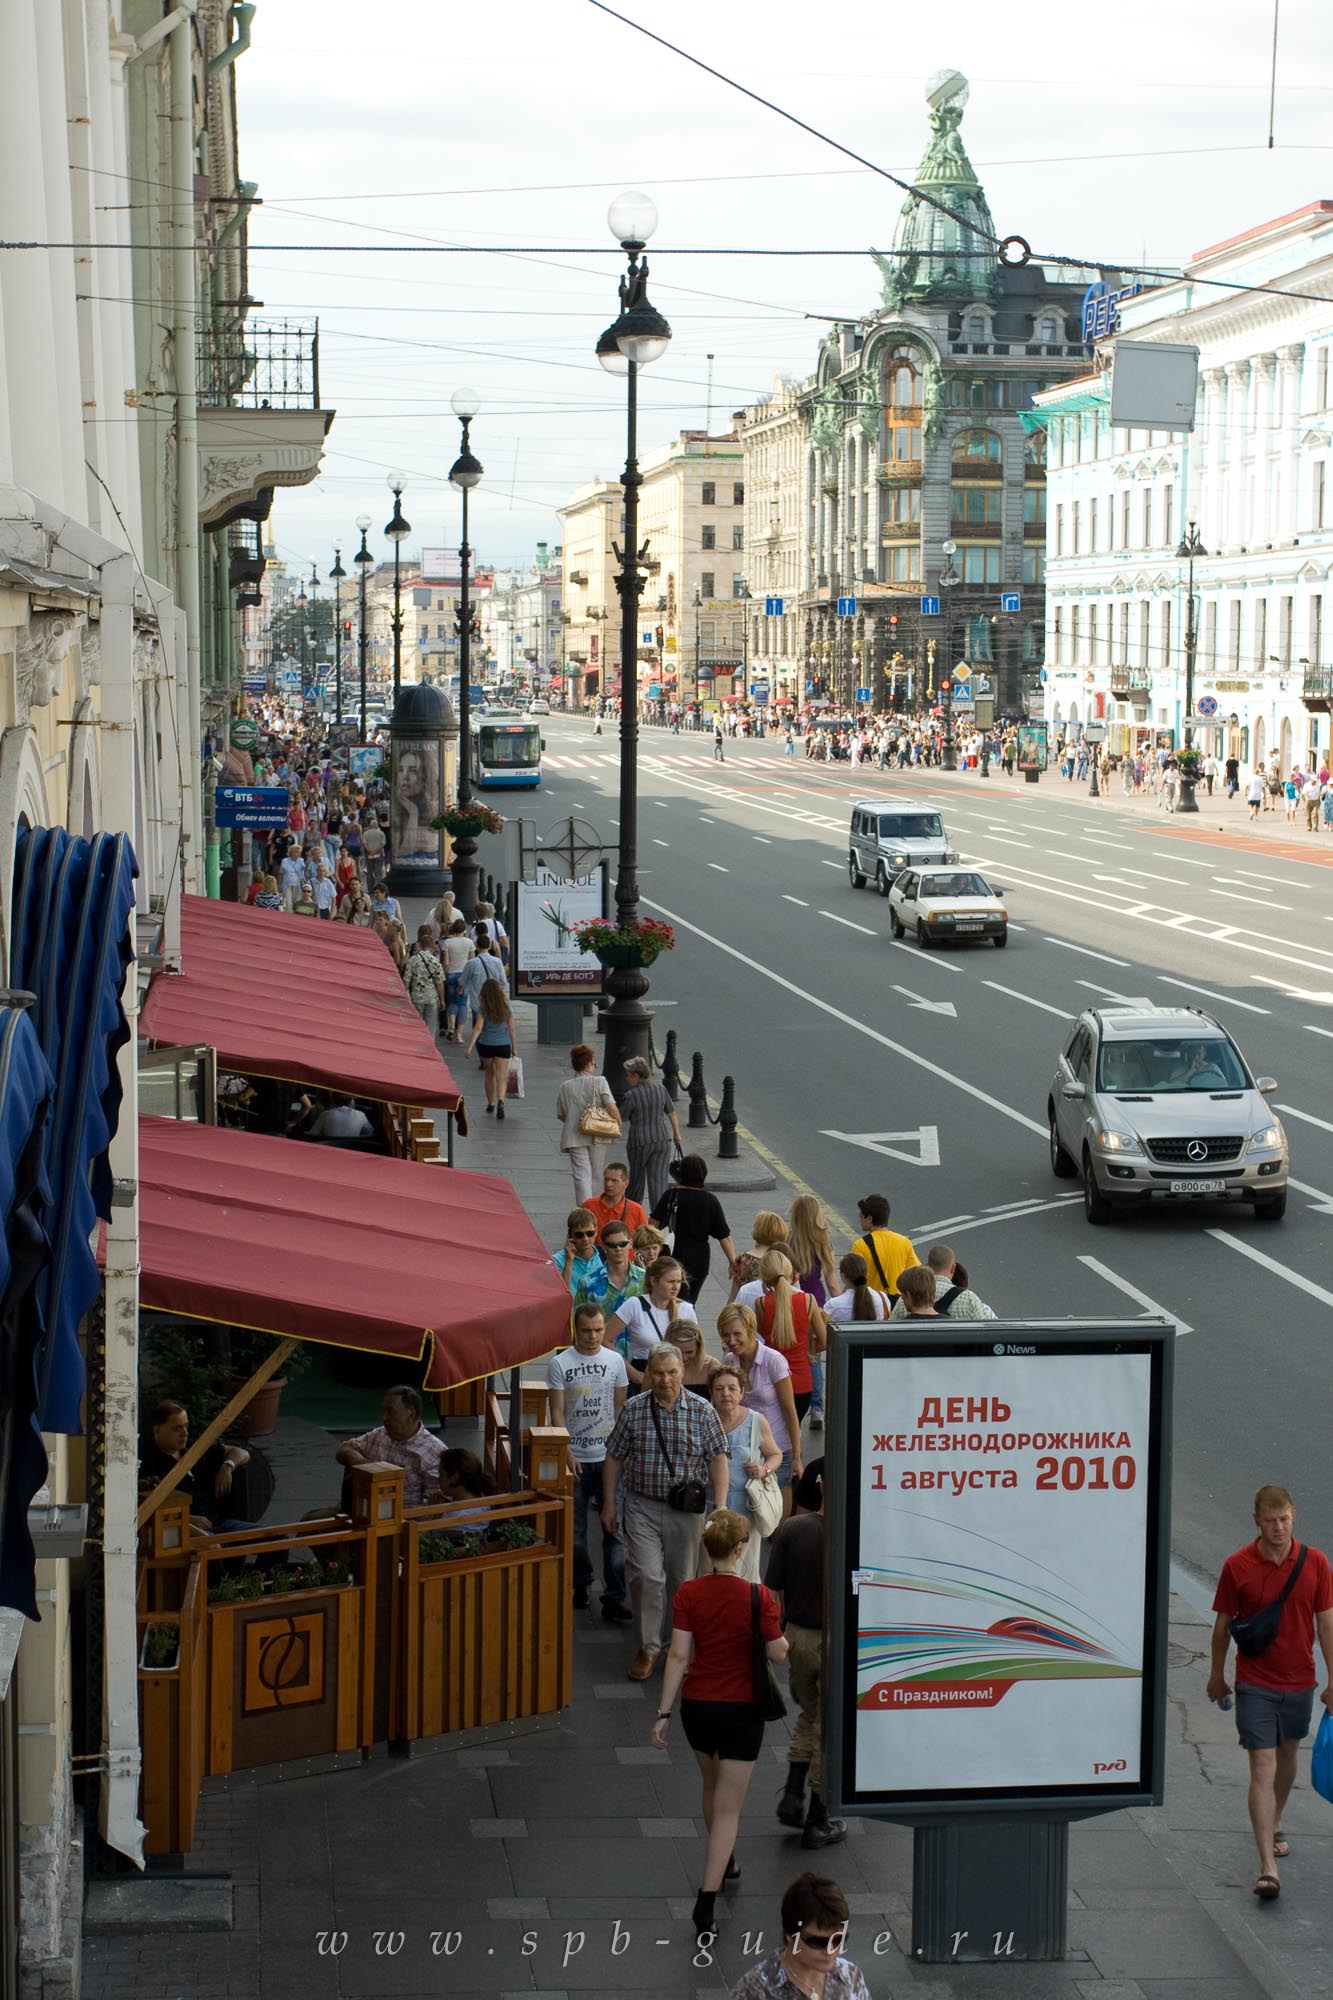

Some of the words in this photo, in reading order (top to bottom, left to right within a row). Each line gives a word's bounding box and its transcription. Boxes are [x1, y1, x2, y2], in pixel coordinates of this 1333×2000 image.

[235, 813, 258, 822] Обмен
[258, 815, 287, 823] валюты
[545, 972, 560, 980] ИЛЬ
[561, 972, 572, 981] ДЕ
[1006, 1344, 1037, 1354] News
[565, 1363, 608, 1382] gritty
[583, 1395, 602, 1407] beat
[576, 1409, 600, 1417] raw
[917, 1396, 1011, 1428] ДЕНЬ
[569, 1436, 608, 1449] angerou
[871, 1431, 1132, 1454] ЖЕЛЕЗНОДОРОЖНИКА
[871, 1464, 887, 1490] 1
[900, 1466, 1018, 1496] августа
[1035, 1456, 1136, 1491] 2010
[878, 1688, 889, 1702] С
[893, 1686, 993, 1705] Праздником!
